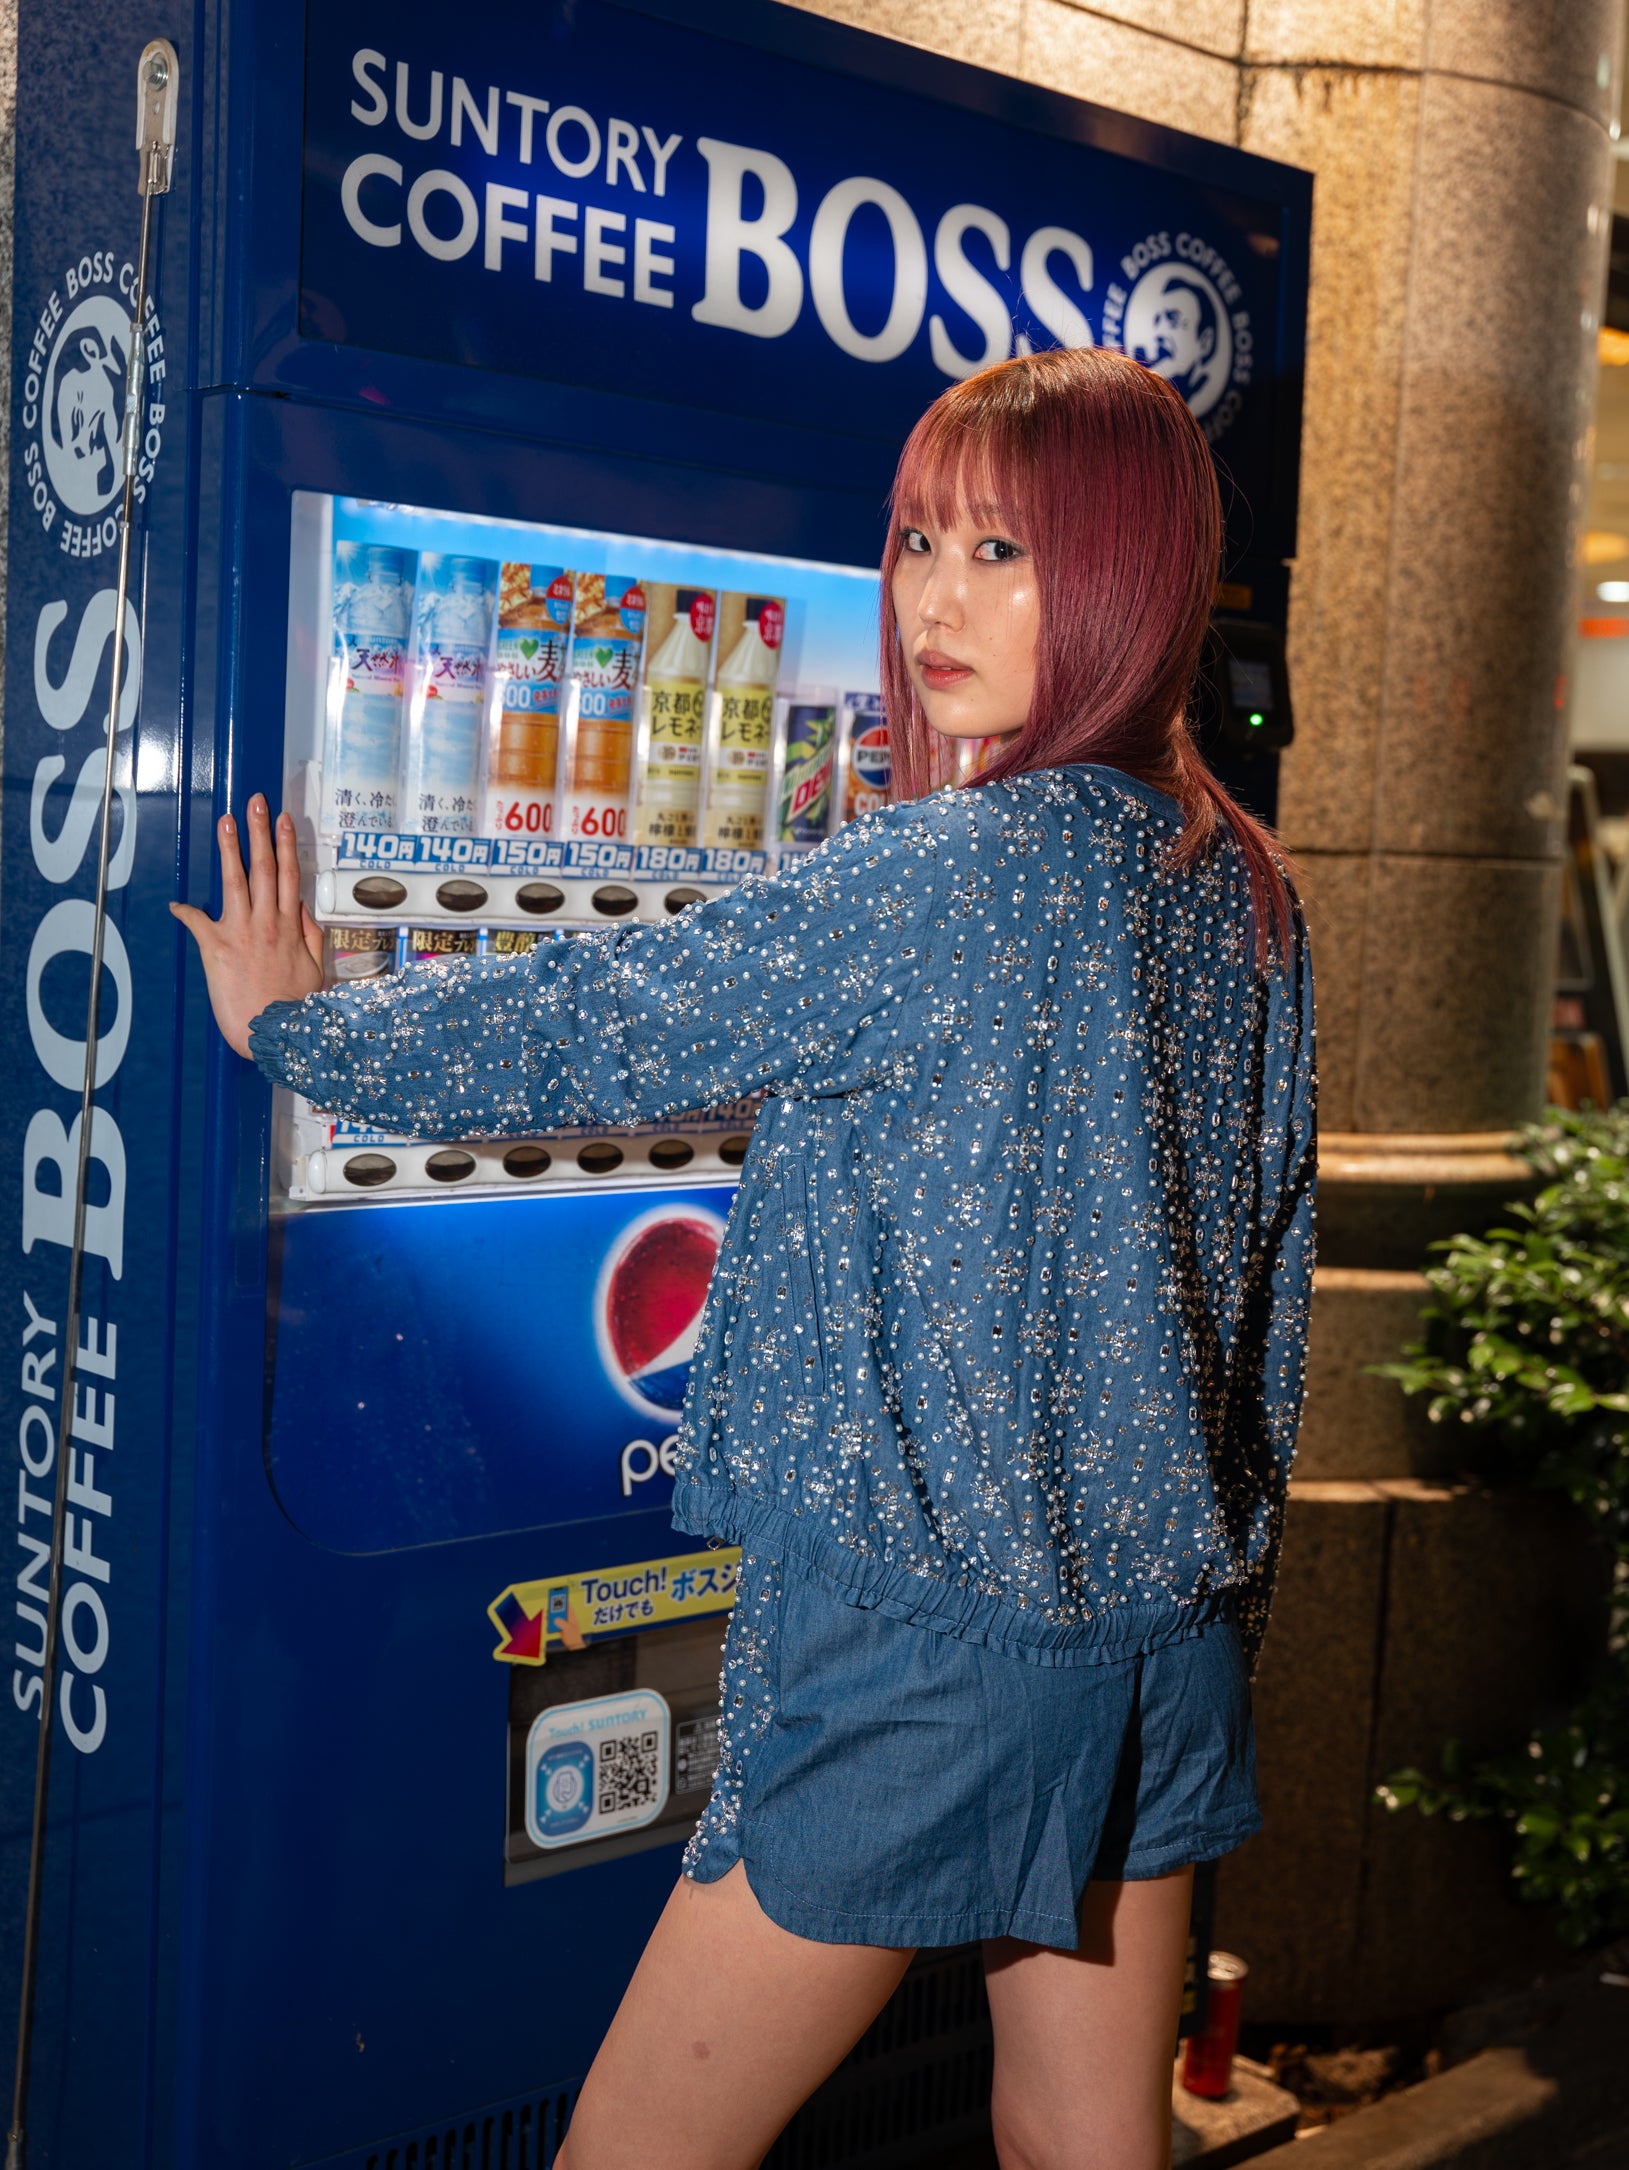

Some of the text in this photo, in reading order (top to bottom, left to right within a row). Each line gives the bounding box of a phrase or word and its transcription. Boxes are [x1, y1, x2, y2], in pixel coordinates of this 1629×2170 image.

[351, 48, 682, 196] SUNTORY
[341, 153, 676, 308] COFFEE
[691, 136, 1094, 380] BOSS
[1120, 231, 1171, 280] BOSS
[1175, 232, 1242, 304] COFFEE
[65, 251, 114, 299] BOSS
[22, 290, 63, 429] COFFEE
[132, 402, 166, 504] BOSS
[24, 441, 56, 532] BOSS
[505, 801, 552, 833] 600
[580, 806, 627, 838] 600
[344, 833, 415, 860] 140円
[420, 836, 489, 864] 140円
[497, 840, 562, 866] 150円
[569, 842, 632, 869] 150円
[638, 846, 701, 871] 180円
[360, 859, 391, 869] COLD
[435, 863, 466, 873] COLD
[510, 866, 539, 875] COLD
[581, 868, 609, 878] COLD
[22, 588, 142, 1281] BOSS
[354, 1134, 384, 1143] COLD
[12, 1291, 58, 1721] SUNTORY
[60, 1316, 117, 1754] COFFEE
[581, 1566, 667, 1604] Touch!
[593, 1599, 654, 1625] だけでも
[588, 1709, 647, 1732] SUNTORY
